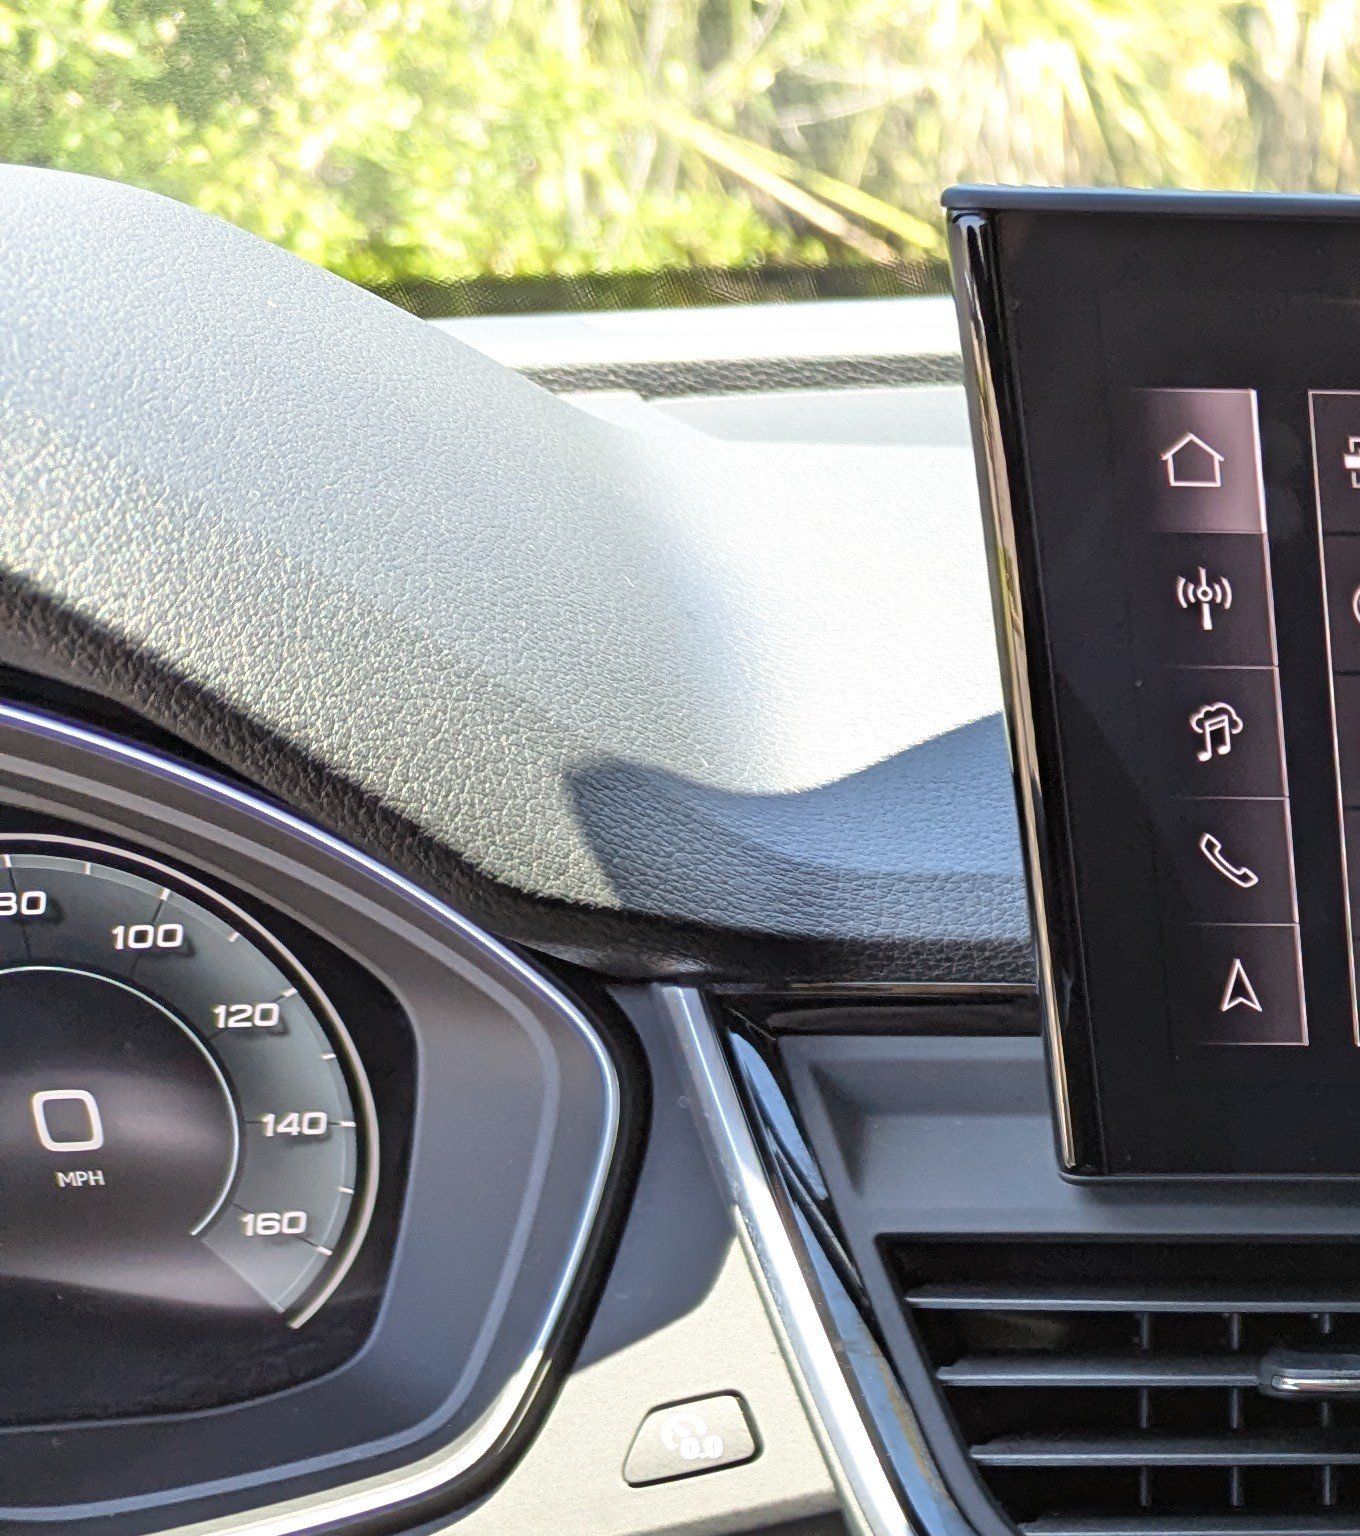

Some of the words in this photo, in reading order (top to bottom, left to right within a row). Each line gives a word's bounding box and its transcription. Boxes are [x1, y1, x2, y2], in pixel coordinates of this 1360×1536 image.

[111, 923, 185, 951] 100
[213, 1003, 280, 1028] 120
[261, 1112, 328, 1137] 140
[57, 1171, 105, 1187] MPH
[241, 1211, 307, 1235] 160
